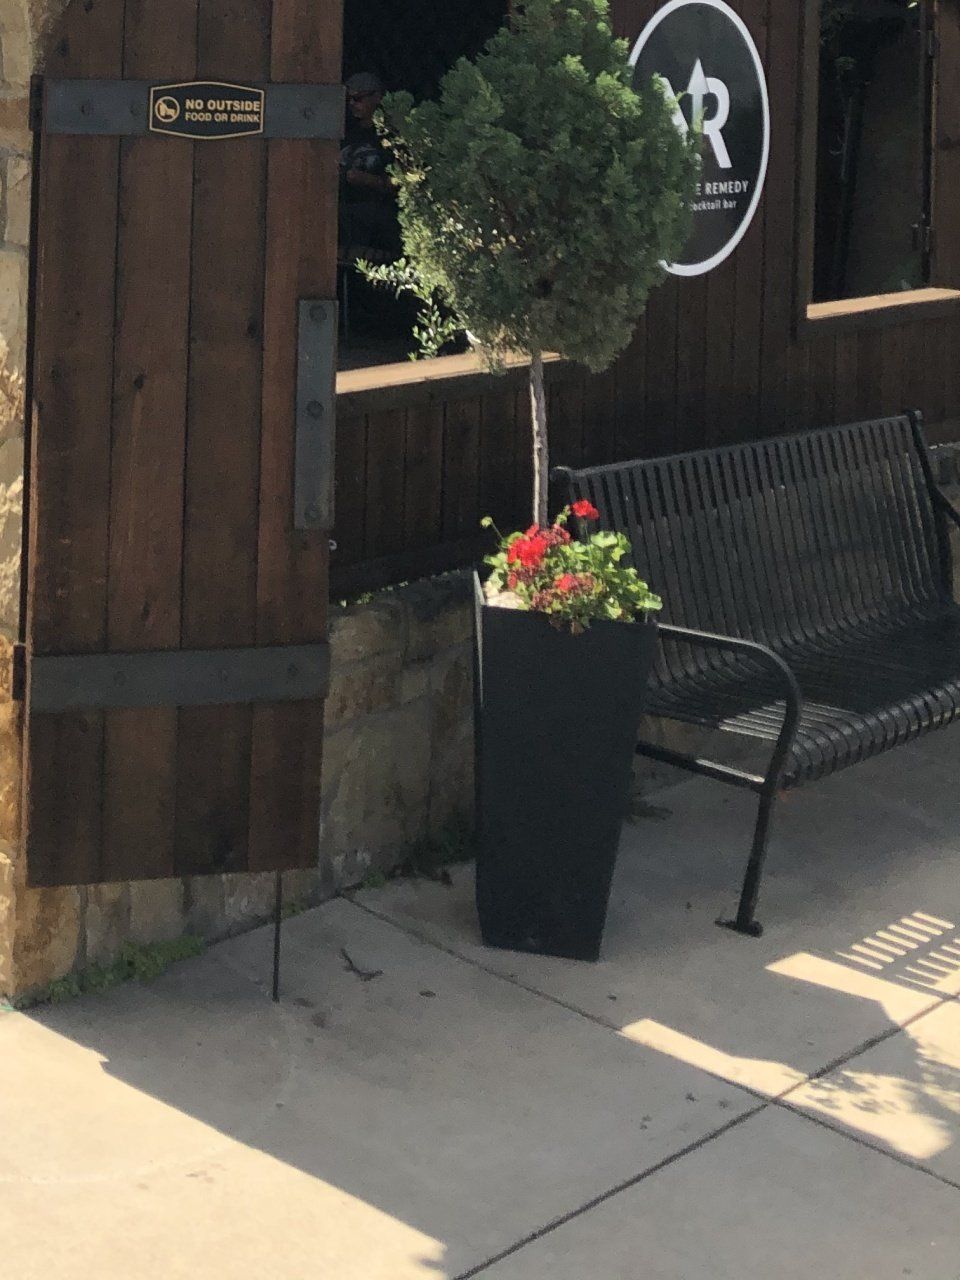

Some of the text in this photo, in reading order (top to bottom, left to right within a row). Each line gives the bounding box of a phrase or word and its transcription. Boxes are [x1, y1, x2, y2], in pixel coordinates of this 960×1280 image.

[185, 99, 261, 112] NO OUTSIDE
[185, 112, 260, 123] FOOD OR DRINK
[704, 180, 749, 195] REMEDY
